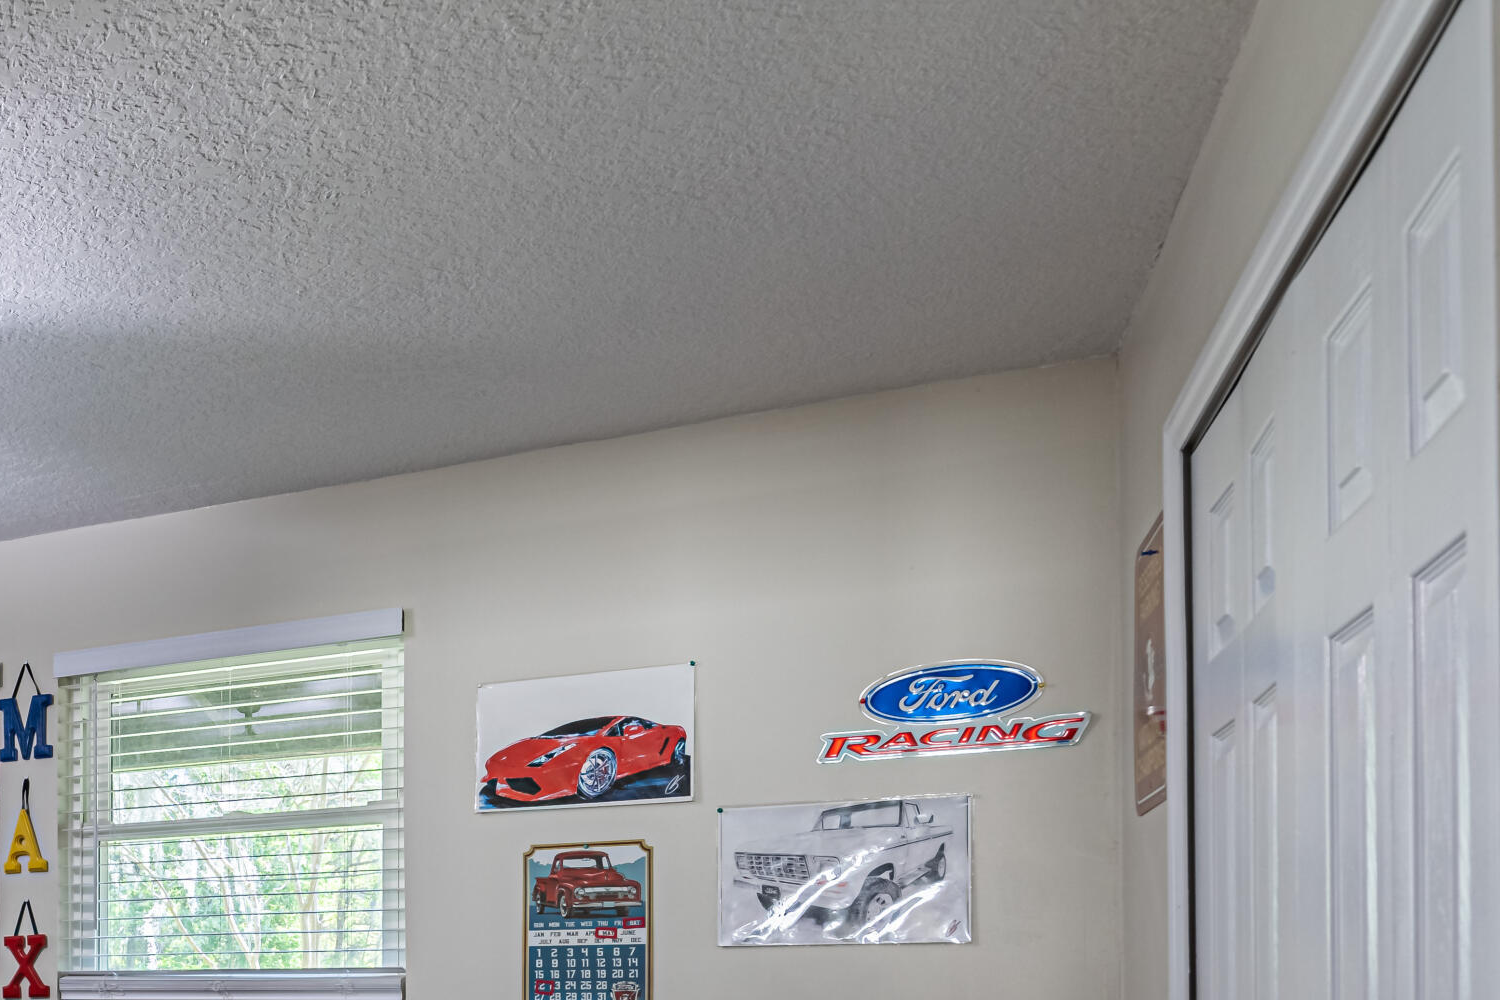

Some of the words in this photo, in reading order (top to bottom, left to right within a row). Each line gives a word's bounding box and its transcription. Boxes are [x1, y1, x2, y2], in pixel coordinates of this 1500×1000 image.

[899, 674, 1000, 713] Ford
[825, 718, 1084, 758] RACING
[536, 948, 541, 957] 1
[551, 948, 558, 957] 2
[567, 948, 574, 957] 3
[581, 947, 588, 956] 4
[629, 947, 636, 956] 7
[535, 959, 543, 968] 8
[551, 959, 558, 968] 9
[566, 959, 576, 968] 10
[582, 958, 589, 967] 11
[597, 958, 606, 967] 12
[612, 958, 621, 967] 13
[628, 957, 638, 966] 14
[534, 970, 544, 979] 15
[550, 970, 560, 979] 16
[566, 970, 576, 979] 17
[580, 969, 591, 978] 18
[596, 969, 606, 978] 19
[612, 969, 623, 978] 20
[628, 969, 639, 978] 21
[565, 981, 576, 990] 24
[580, 981, 592, 990] 25
[565, 992, 577, 1000] 29
[580, 992, 592, 1000] 30
[597, 992, 606, 1000] 31
